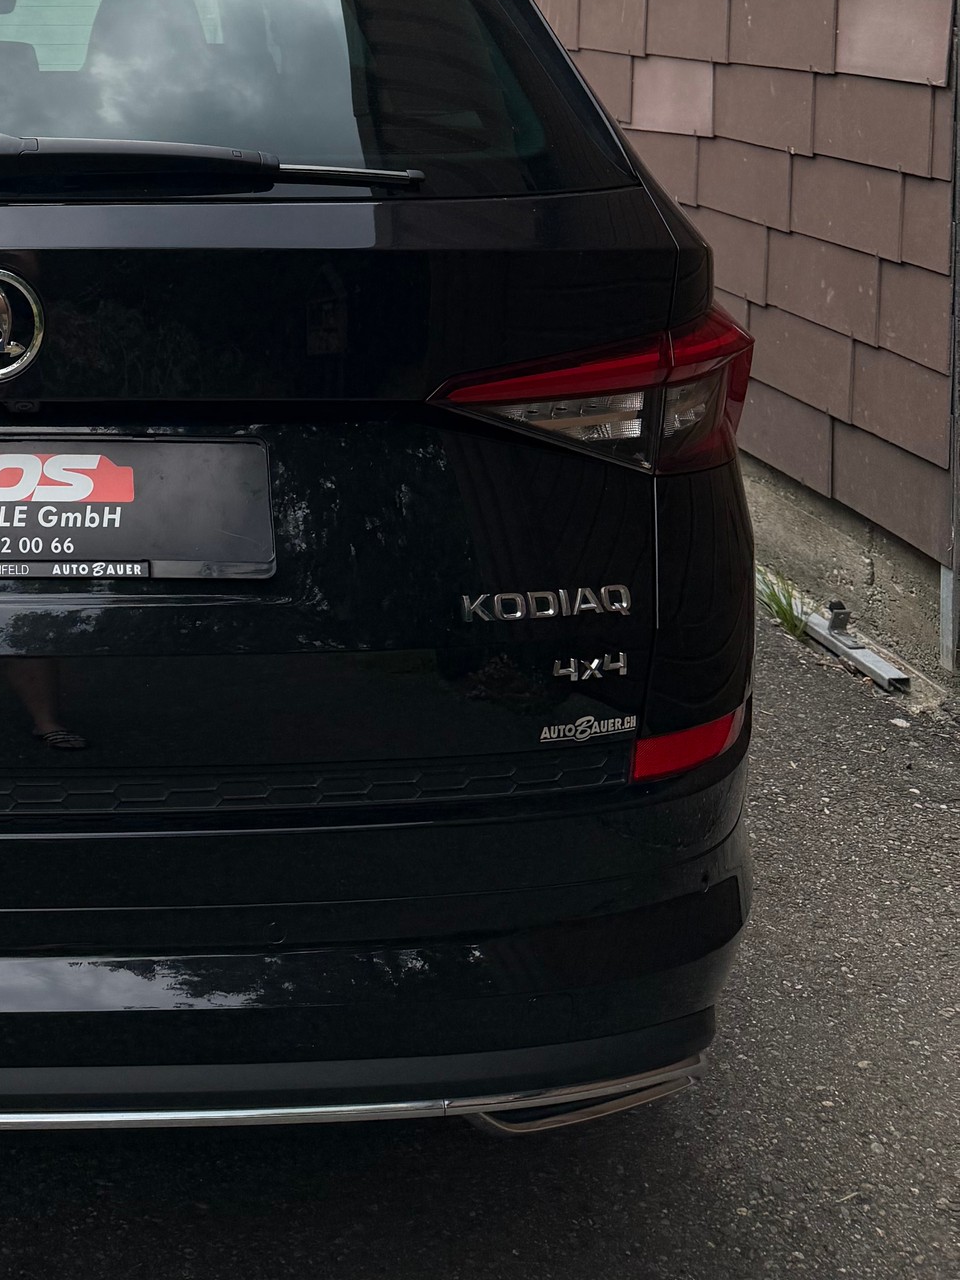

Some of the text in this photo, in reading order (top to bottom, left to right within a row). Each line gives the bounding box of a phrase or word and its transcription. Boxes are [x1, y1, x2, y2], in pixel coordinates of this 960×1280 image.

[37, 505, 122, 528] GmbH
[18, 536, 43, 554] 00
[50, 536, 75, 554] 66
[461, 584, 632, 622] KODIAQ
